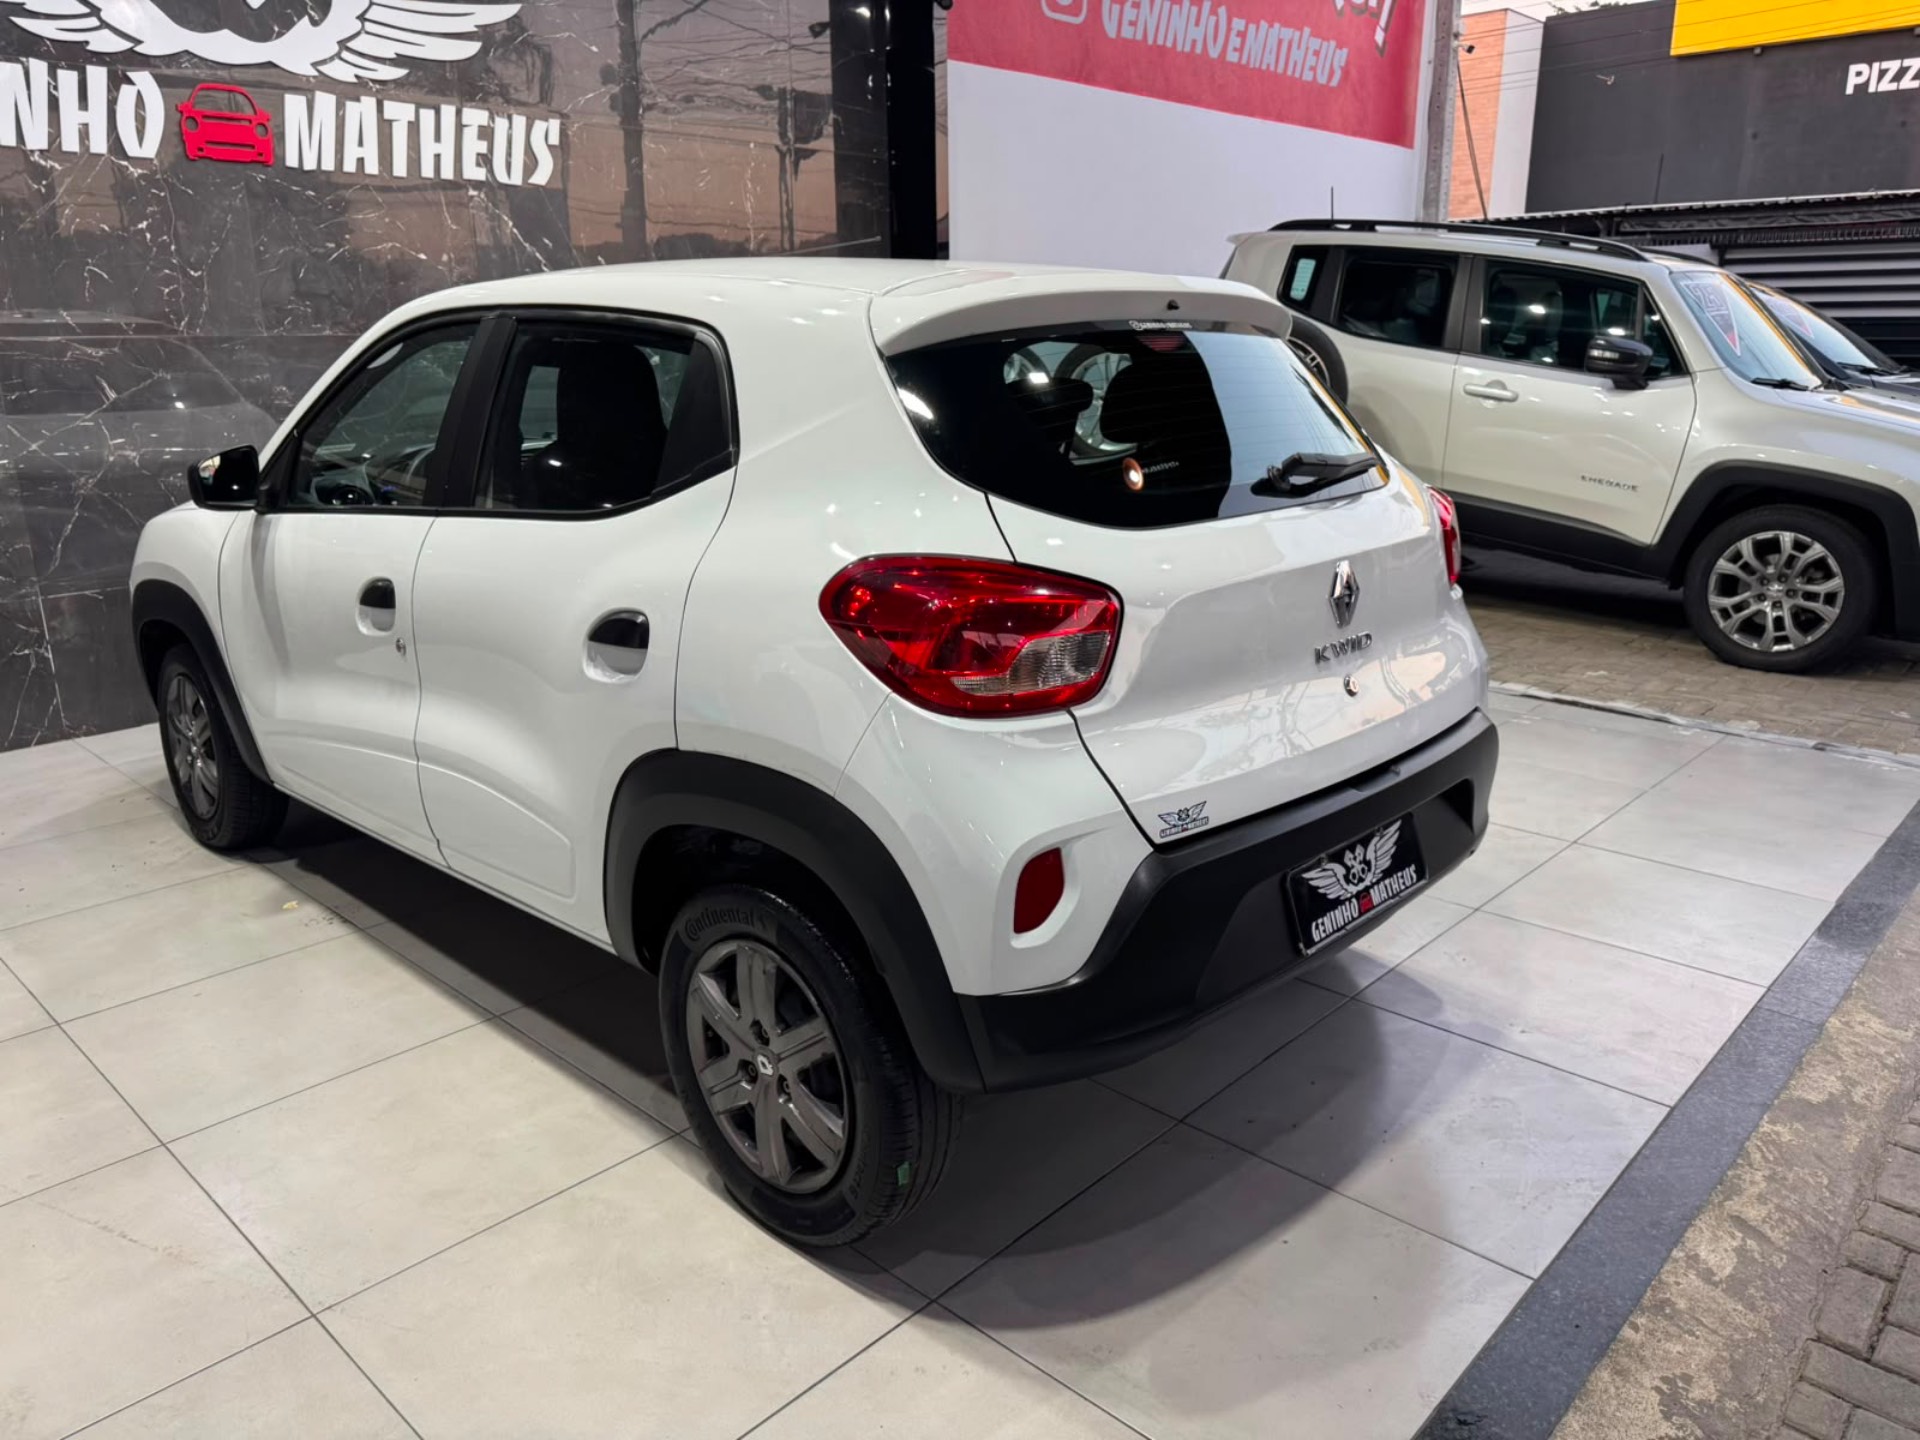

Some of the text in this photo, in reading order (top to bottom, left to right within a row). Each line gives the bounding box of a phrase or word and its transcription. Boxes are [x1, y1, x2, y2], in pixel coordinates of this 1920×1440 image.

[1845, 57, 1920, 95] PIZZ
[284, 90, 561, 186] MATHEUS
[1314, 631, 1372, 664] KWID
[1311, 864, 1417, 942] GENINHO MATHEUS
[685, 906, 755, 941] Continental
